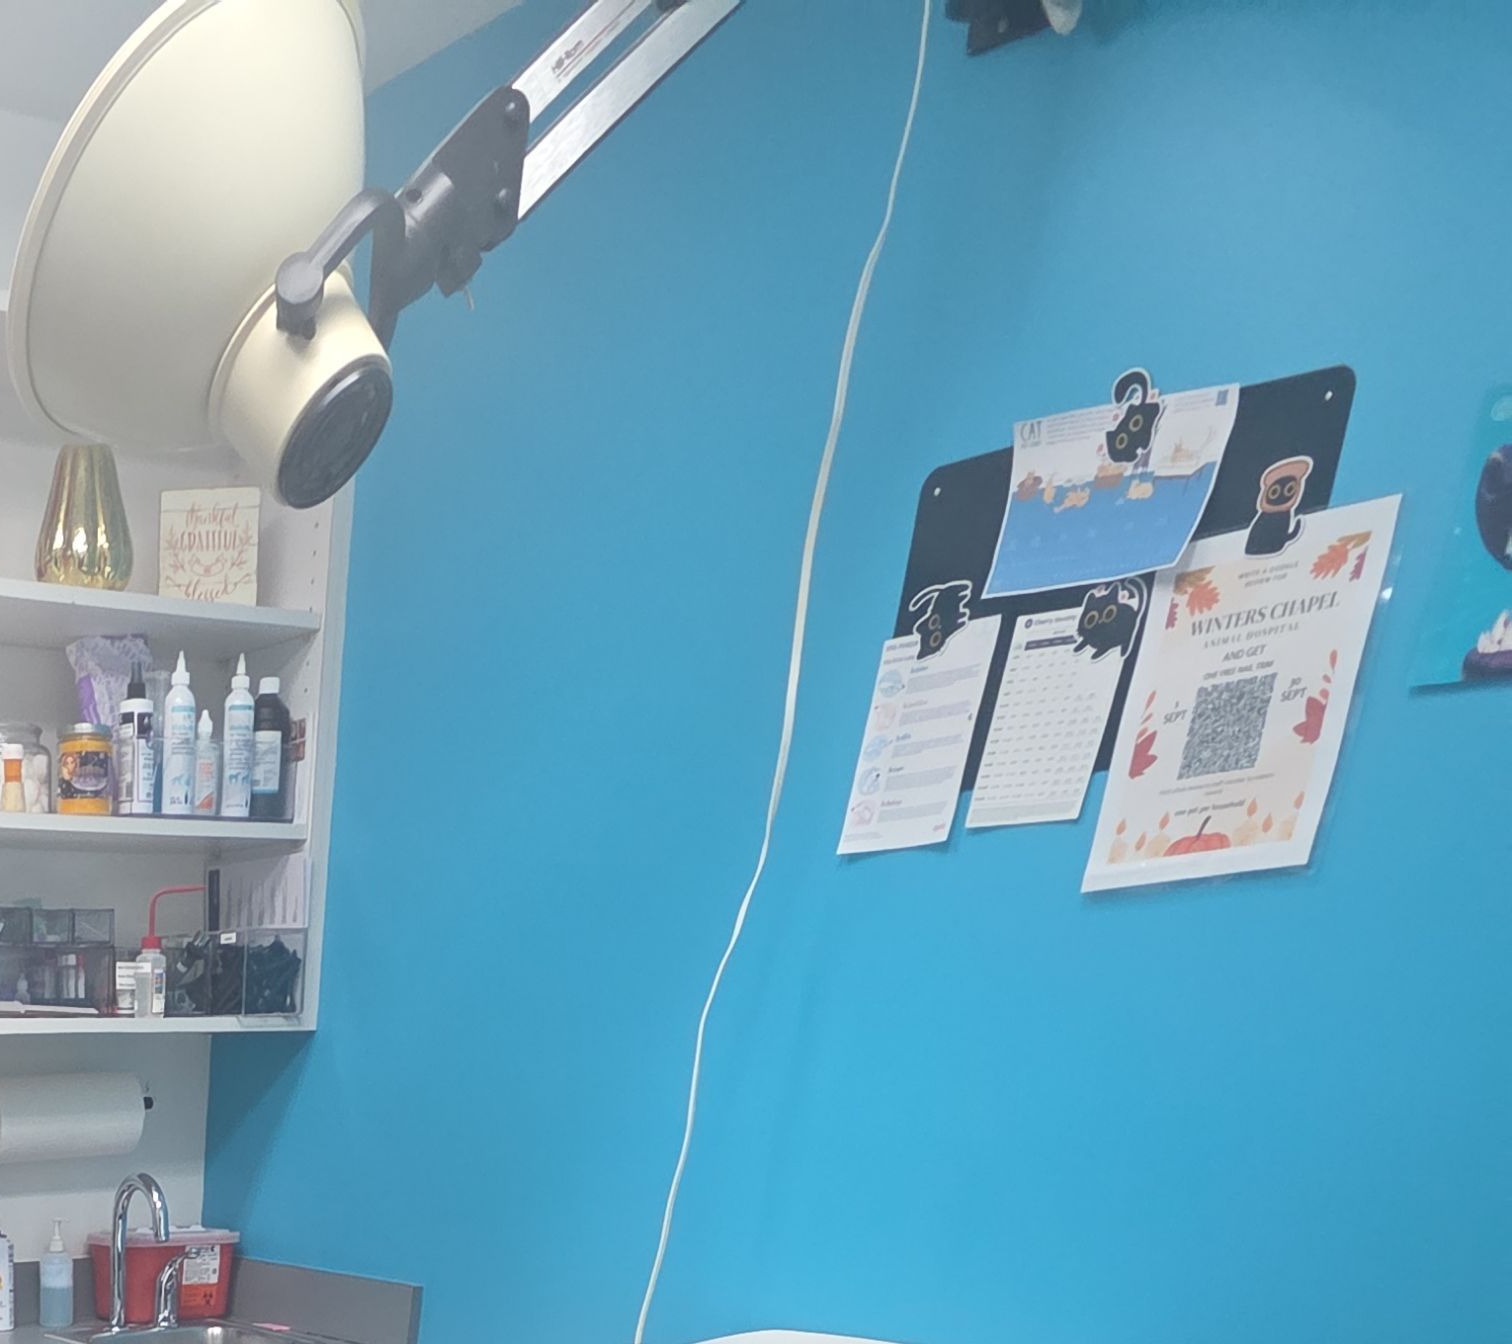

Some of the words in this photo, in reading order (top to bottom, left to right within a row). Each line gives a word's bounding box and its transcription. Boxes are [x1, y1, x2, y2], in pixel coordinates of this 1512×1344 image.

[1020, 420, 1043, 441] CAT
[1191, 606, 1267, 636] WINTERS
[1270, 591, 1339, 620] CHAPEL
[1222, 648, 1245, 662] AND
[1246, 644, 1267, 657] GET
[1280, 686, 1308, 703] SEPT
[1163, 708, 1188, 725] SEPT
